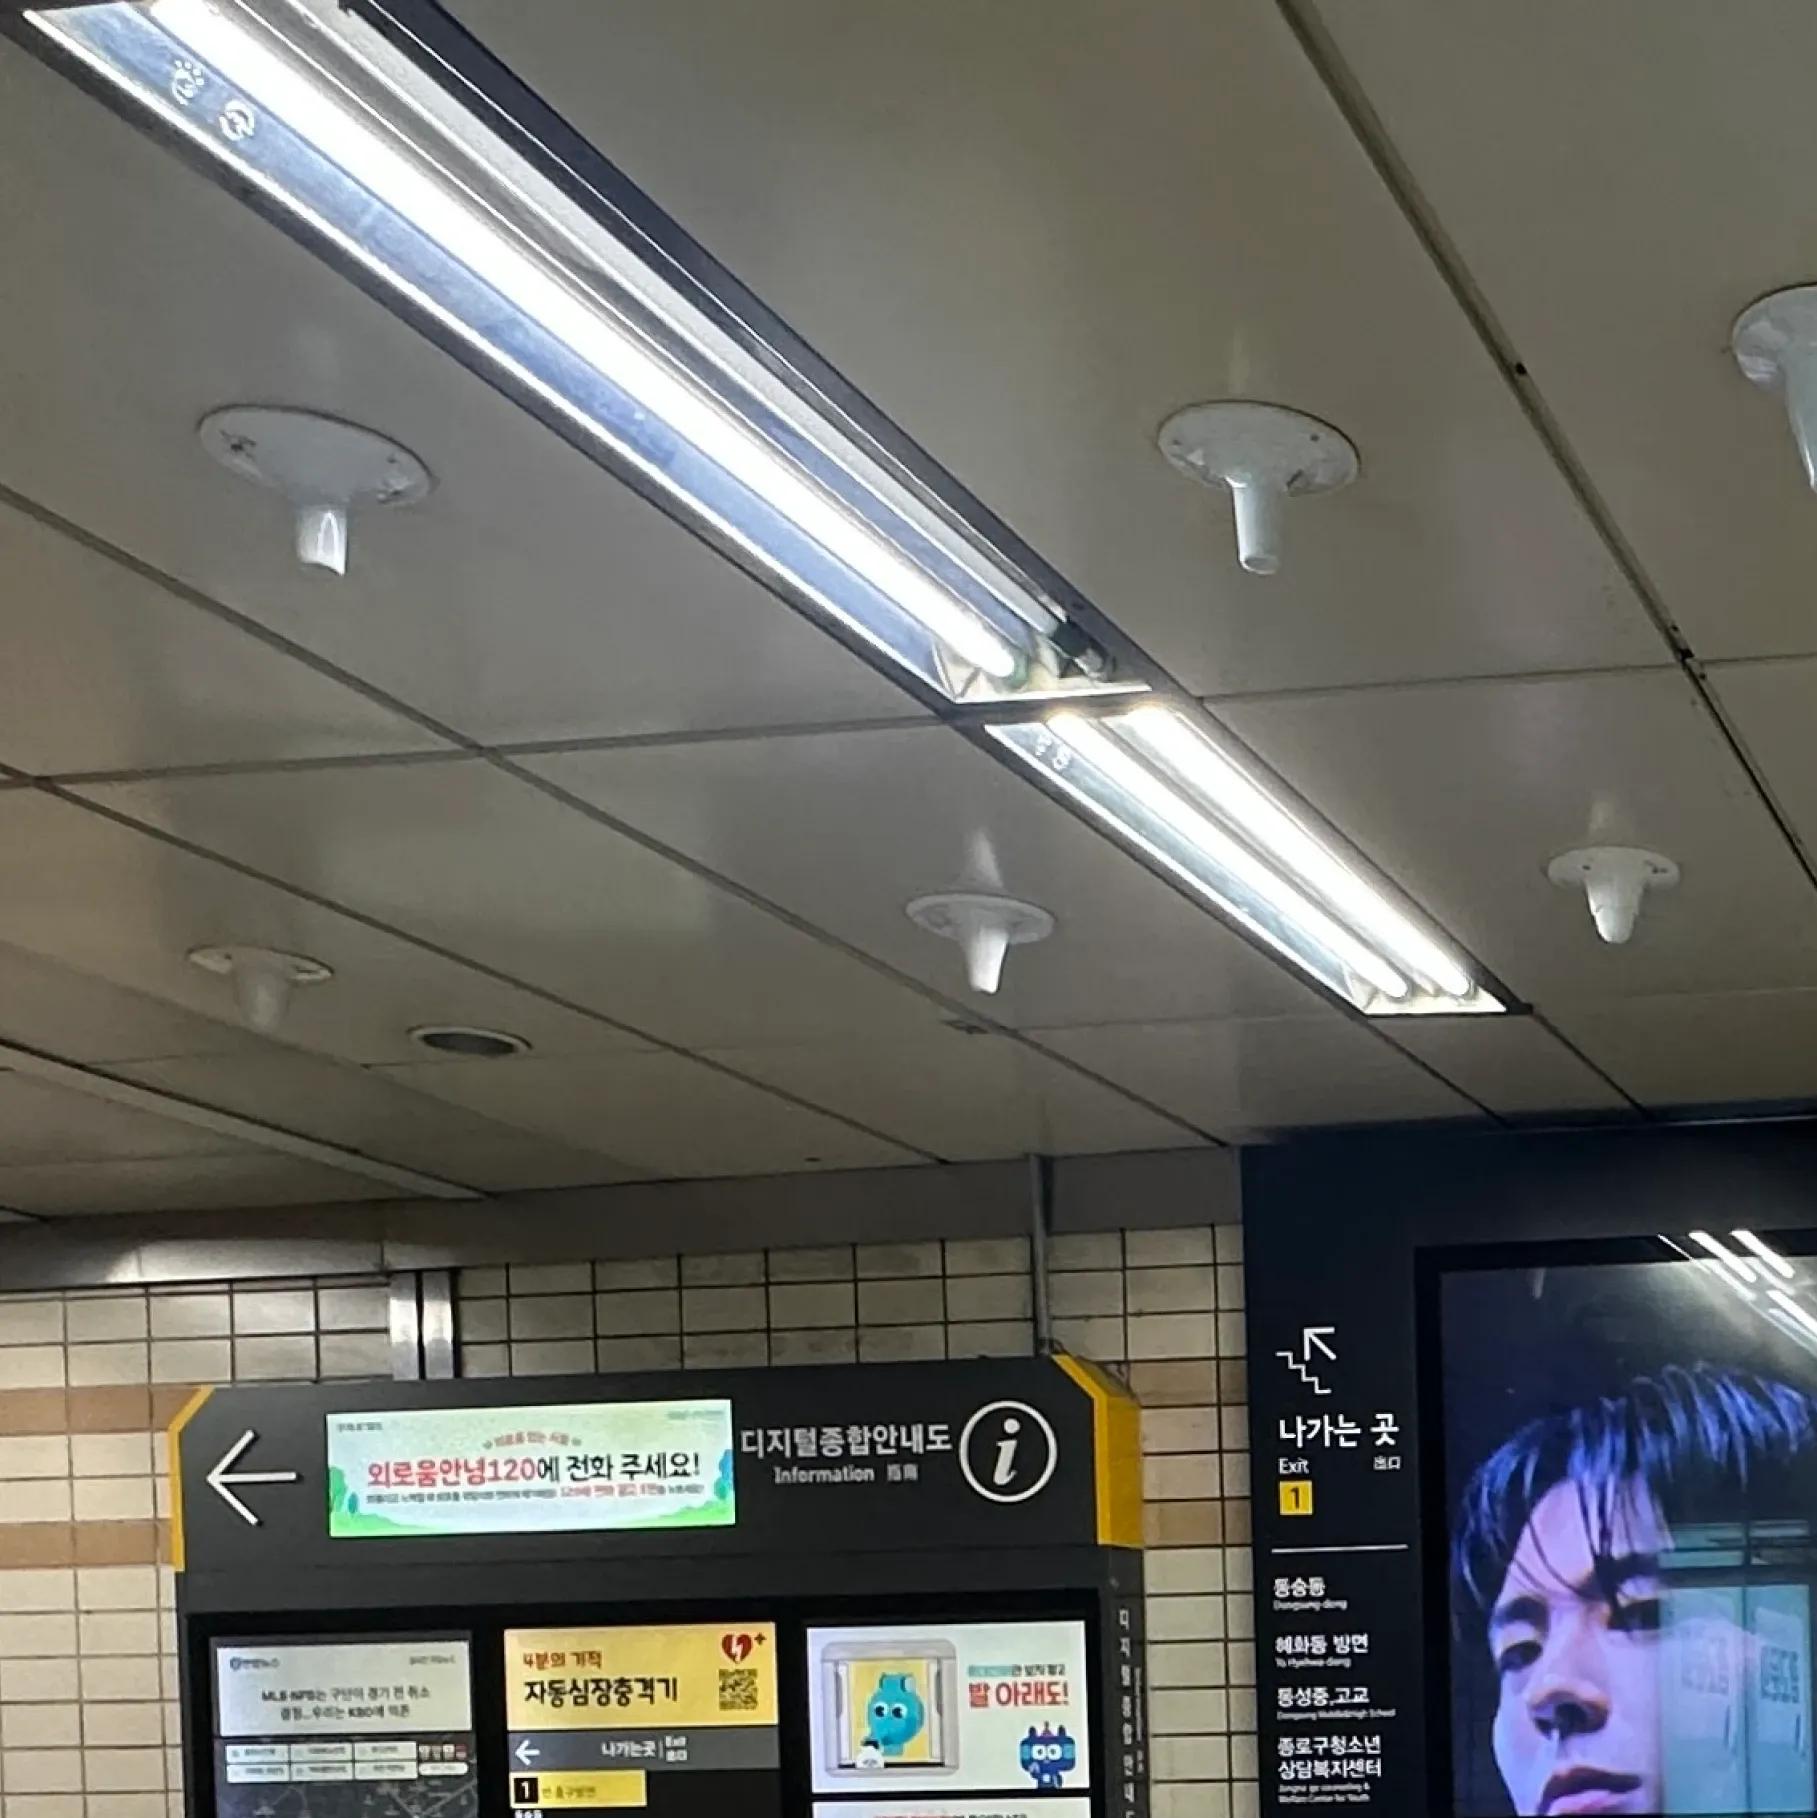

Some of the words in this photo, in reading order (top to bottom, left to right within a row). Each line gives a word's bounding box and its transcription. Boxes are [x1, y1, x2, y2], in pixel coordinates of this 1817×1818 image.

[741, 1423, 952, 1459] 디지털종합안내도
[1279, 1414, 1362, 1448] 나가는
[1370, 1413, 1400, 1446] 곳
[566, 1453, 614, 1481] 전화
[620, 1451, 699, 1480] 주세요!
[773, 1464, 875, 1484] Information
[1278, 1457, 1310, 1474] Exit
[1373, 1456, 1401, 1470] 出口
[1275, 1634, 1327, 1654] 혜화동
[1333, 1633, 1368, 1653] 방면
[524, 1677, 679, 1708] 자동심장충격기
[996, 1681, 1069, 1706] 아래도!
[1278, 1735, 1382, 1756] 종로구청소년
[1278, 1758, 1382, 1780] 상담복지센터
